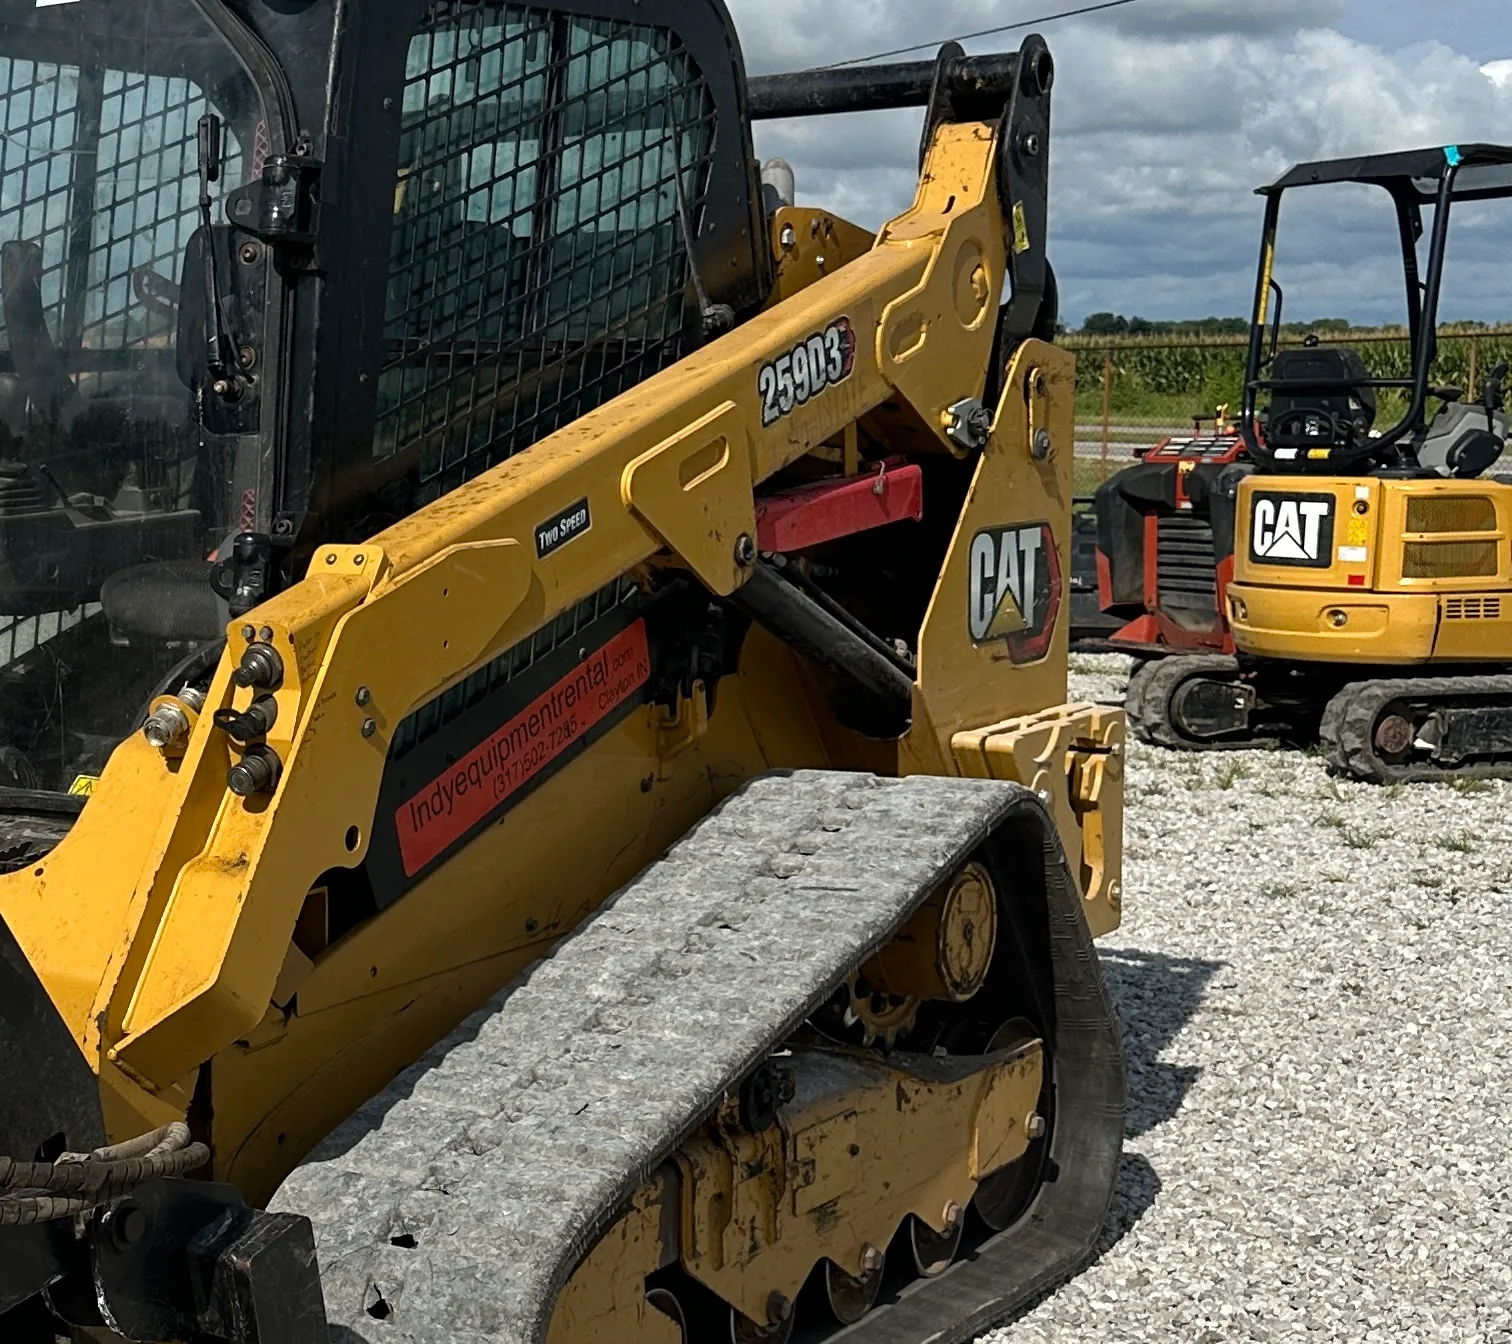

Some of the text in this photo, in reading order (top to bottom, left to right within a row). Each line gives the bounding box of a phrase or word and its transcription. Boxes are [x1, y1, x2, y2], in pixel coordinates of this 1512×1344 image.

[759, 326, 843, 424] 259D3
[559, 509, 587, 537] SPEED
[1253, 499, 1329, 560] CAT
[970, 526, 1042, 640] CAT
[597, 658, 649, 710] Clayton IN
